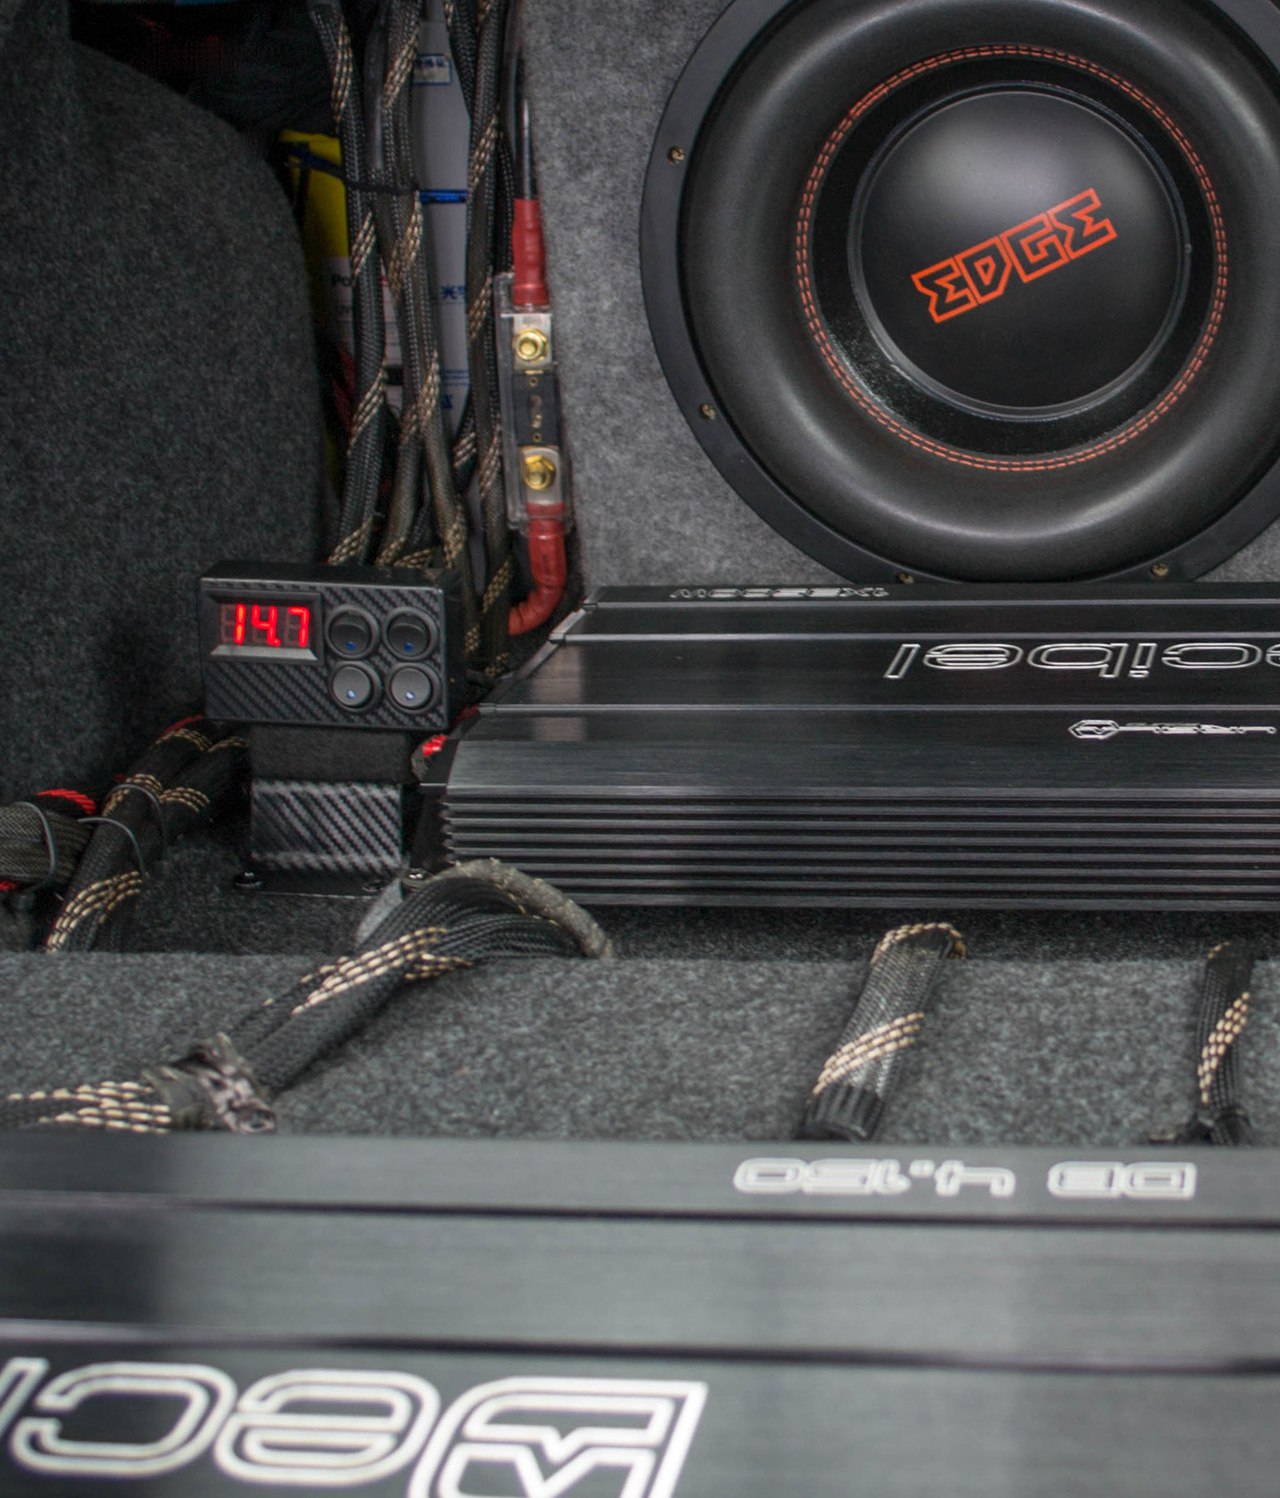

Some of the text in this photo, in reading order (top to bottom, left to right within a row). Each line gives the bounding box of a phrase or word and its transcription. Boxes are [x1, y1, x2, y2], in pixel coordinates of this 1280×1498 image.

[911, 187, 1118, 323] EDGE
[233, 603, 311, 647] 14.7
[733, 1158, 1197, 1198] DB 4.150
